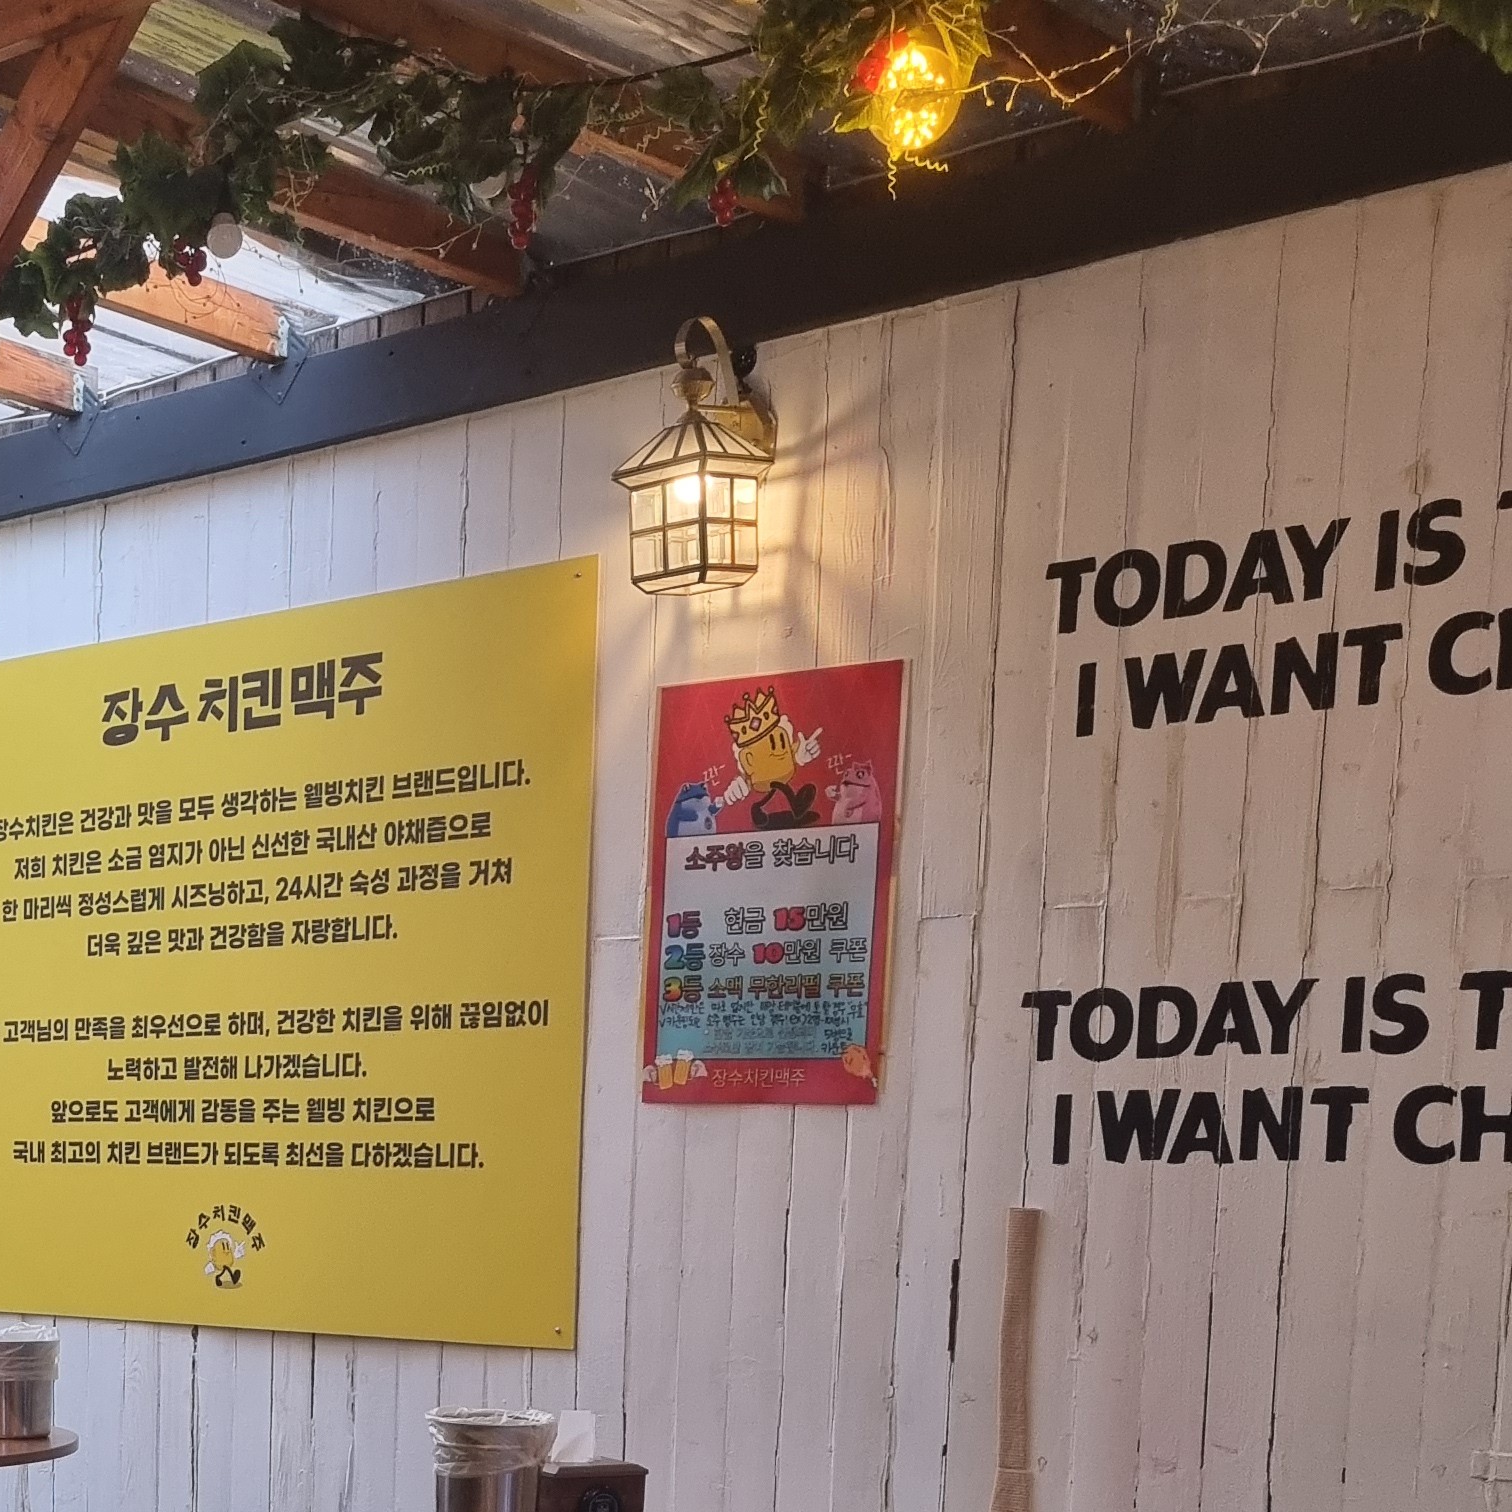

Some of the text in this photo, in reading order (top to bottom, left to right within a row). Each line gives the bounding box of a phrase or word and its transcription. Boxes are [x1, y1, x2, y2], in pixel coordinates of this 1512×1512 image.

[1046, 498, 1466, 634] TODAY IS
[1076, 608, 1512, 738] I WANT C
[81, 805, 131, 832] 건강과
[138, 800, 172, 826] 맛을
[179, 795, 214, 821] 모두
[221, 787, 297, 817] 생각하는
[304, 776, 384, 809] 웰빙치킨
[392, 759, 530, 799] 브랜드입니다.
[15, 812, 491, 879] 저희 치킨은 소금 염지가 아닌 신선한 국내산 야채즙으로
[685, 833, 859, 872] 소주왕을 찾습니다
[3, 858, 511, 922] 한 마리씩 정성스럽게 시즈닝하고, 24시간 숙성 과정을 거쳐
[88, 914, 397, 956] 더욱 깊은 맛과 건강함을 자랑합니다.
[666, 901, 849, 939] 1등 현금 15만원
[664, 937, 868, 971] 2등 장수 10만원 쿠폰
[662, 972, 865, 1003] 3등 소맥 무한리필 쿠폰
[3, 1019, 68, 1042] 고객님의
[75, 1016, 125, 1040] 만족을
[132, 1013, 221, 1039] 최우선으로
[228, 1011, 269, 1036] 하며,
[278, 1008, 335, 1034] 건강한
[342, 1006, 402, 1032] 치킨을
[410, 1004, 452, 1030] 위해
[460, 1000, 548, 1029] 끊임없이
[1021, 978, 1320, 1062] TODAY
[1342, 973, 1430, 1055] IS
[108, 1052, 366, 1081] 노력하고 발전해 나가겠습니다.
[712, 1067, 806, 1088] 장수치킨맥주
[51, 1098, 434, 1123] 앞으로도 고객에게 감동을 주는 웰빙 치킨으로
[1053, 1094, 1073, 1165] I
[1097, 1086, 1369, 1168] WANT
[13, 1141, 484, 1168] 국내 최고의 치킨 브랜드가 되도록 최선을 다하겠습니다.
